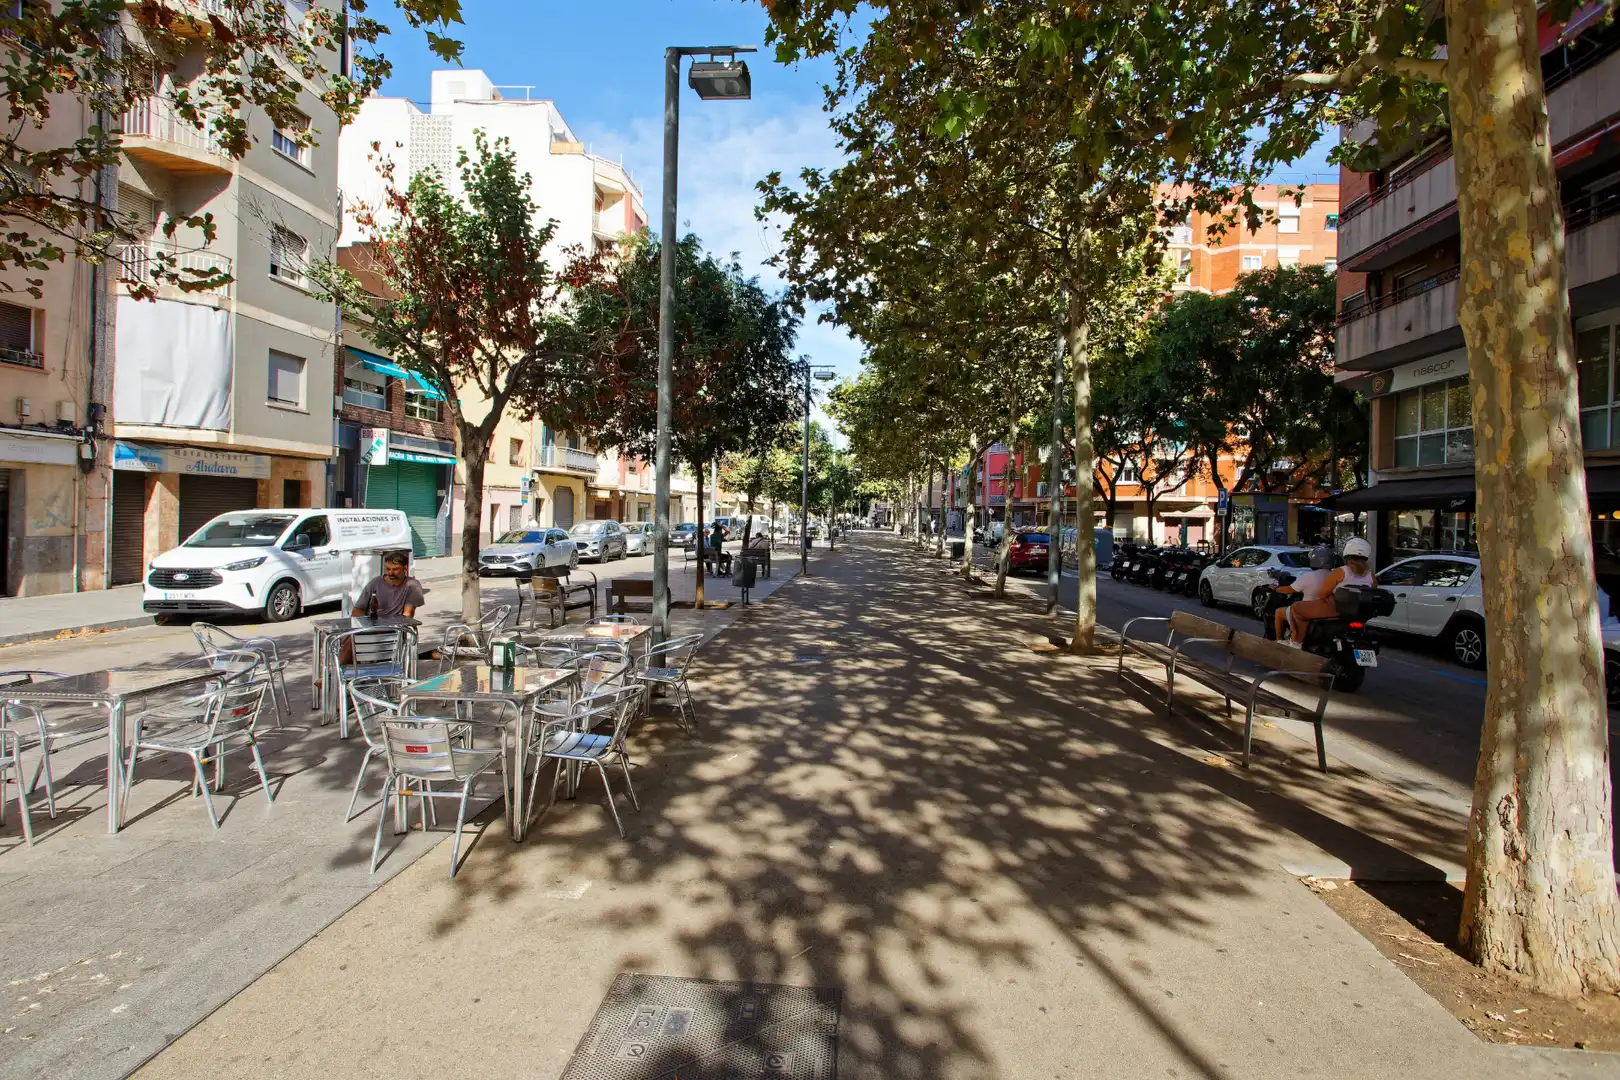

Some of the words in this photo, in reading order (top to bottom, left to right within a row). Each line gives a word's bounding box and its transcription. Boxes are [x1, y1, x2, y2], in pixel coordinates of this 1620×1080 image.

[1413, 360, 1455, 378] nascor
[1220, 491, 1226, 506] P
[337, 515, 389, 523] INSTALACIONES
